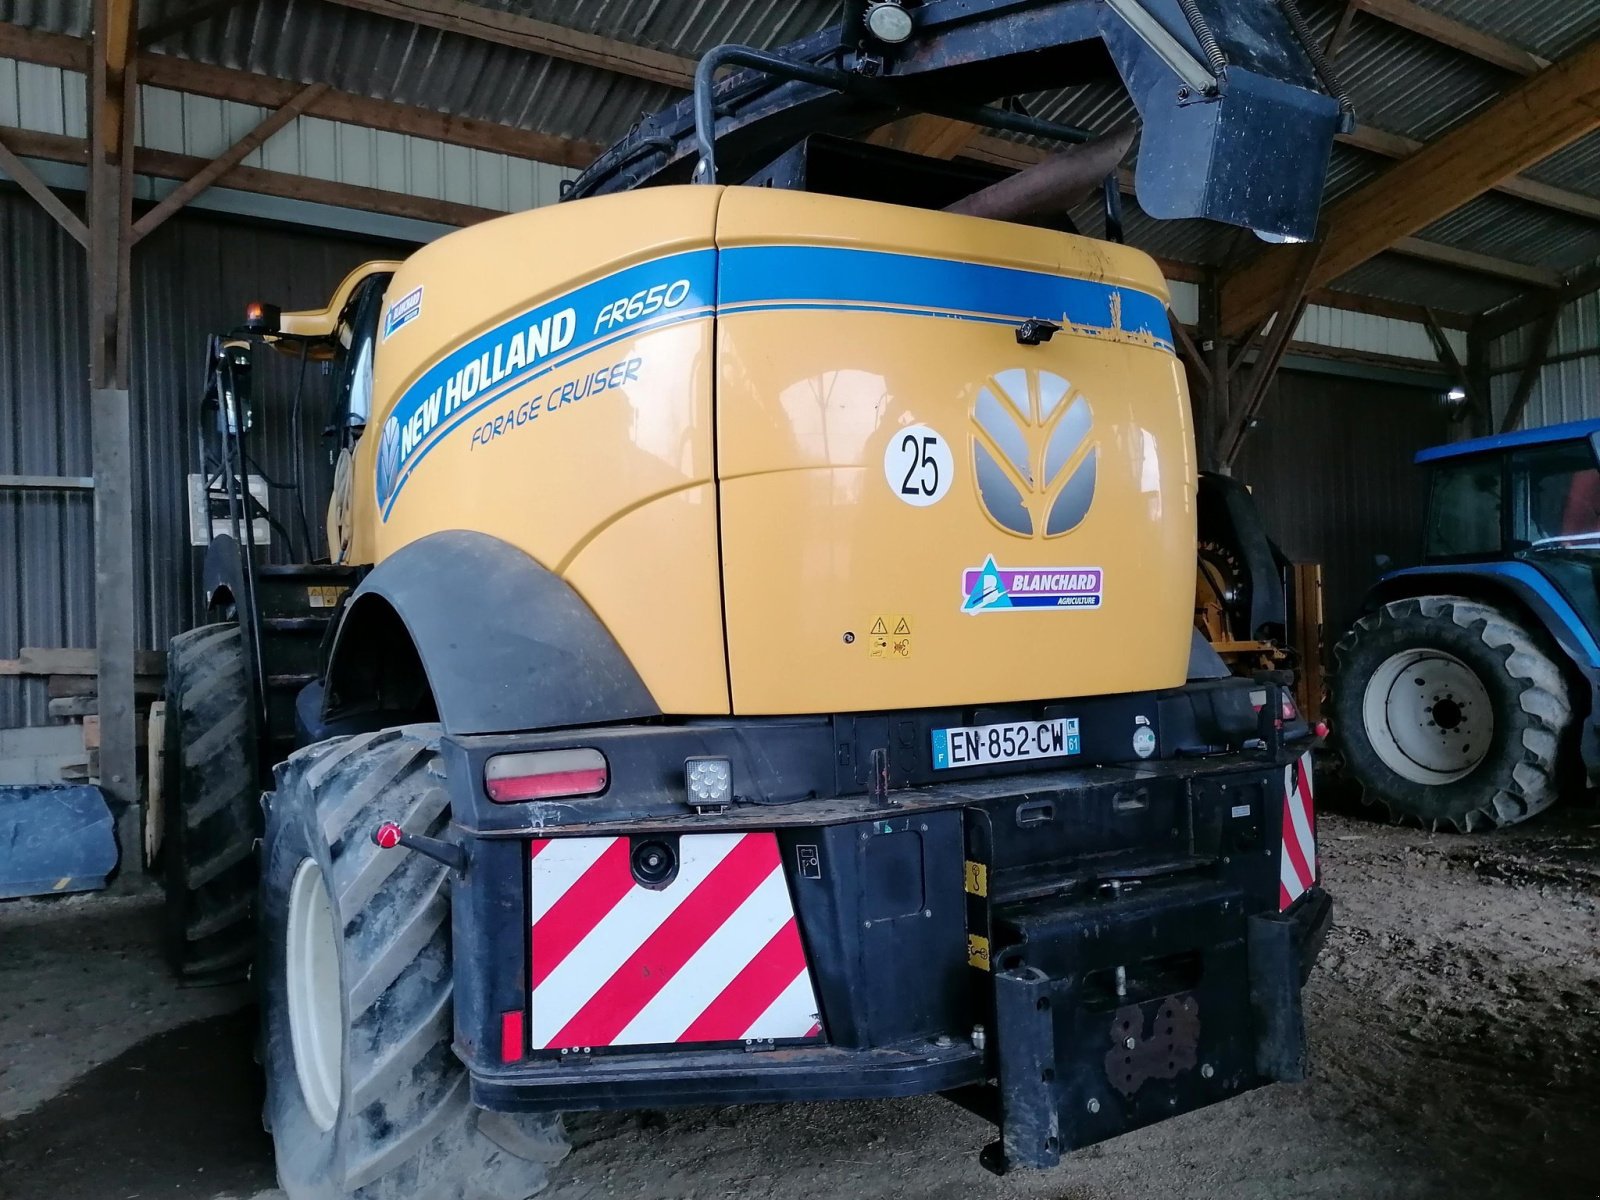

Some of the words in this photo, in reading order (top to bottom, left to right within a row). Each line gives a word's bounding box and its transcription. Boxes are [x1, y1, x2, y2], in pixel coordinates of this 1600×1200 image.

[594, 279, 690, 335] FR650
[401, 384, 444, 463] NEW
[445, 307, 577, 417] HOLLAND
[471, 395, 543, 452] FORAGE
[547, 357, 642, 412] CRUISER
[901, 434, 939, 497] 25
[1012, 573, 1097, 592] BLANCHARD
[1057, 596, 1096, 606] AGRICULTURE
[938, 753, 945, 763] F
[950, 722, 1064, 763] EN-852-CW
[1068, 738, 1079, 751] 61
